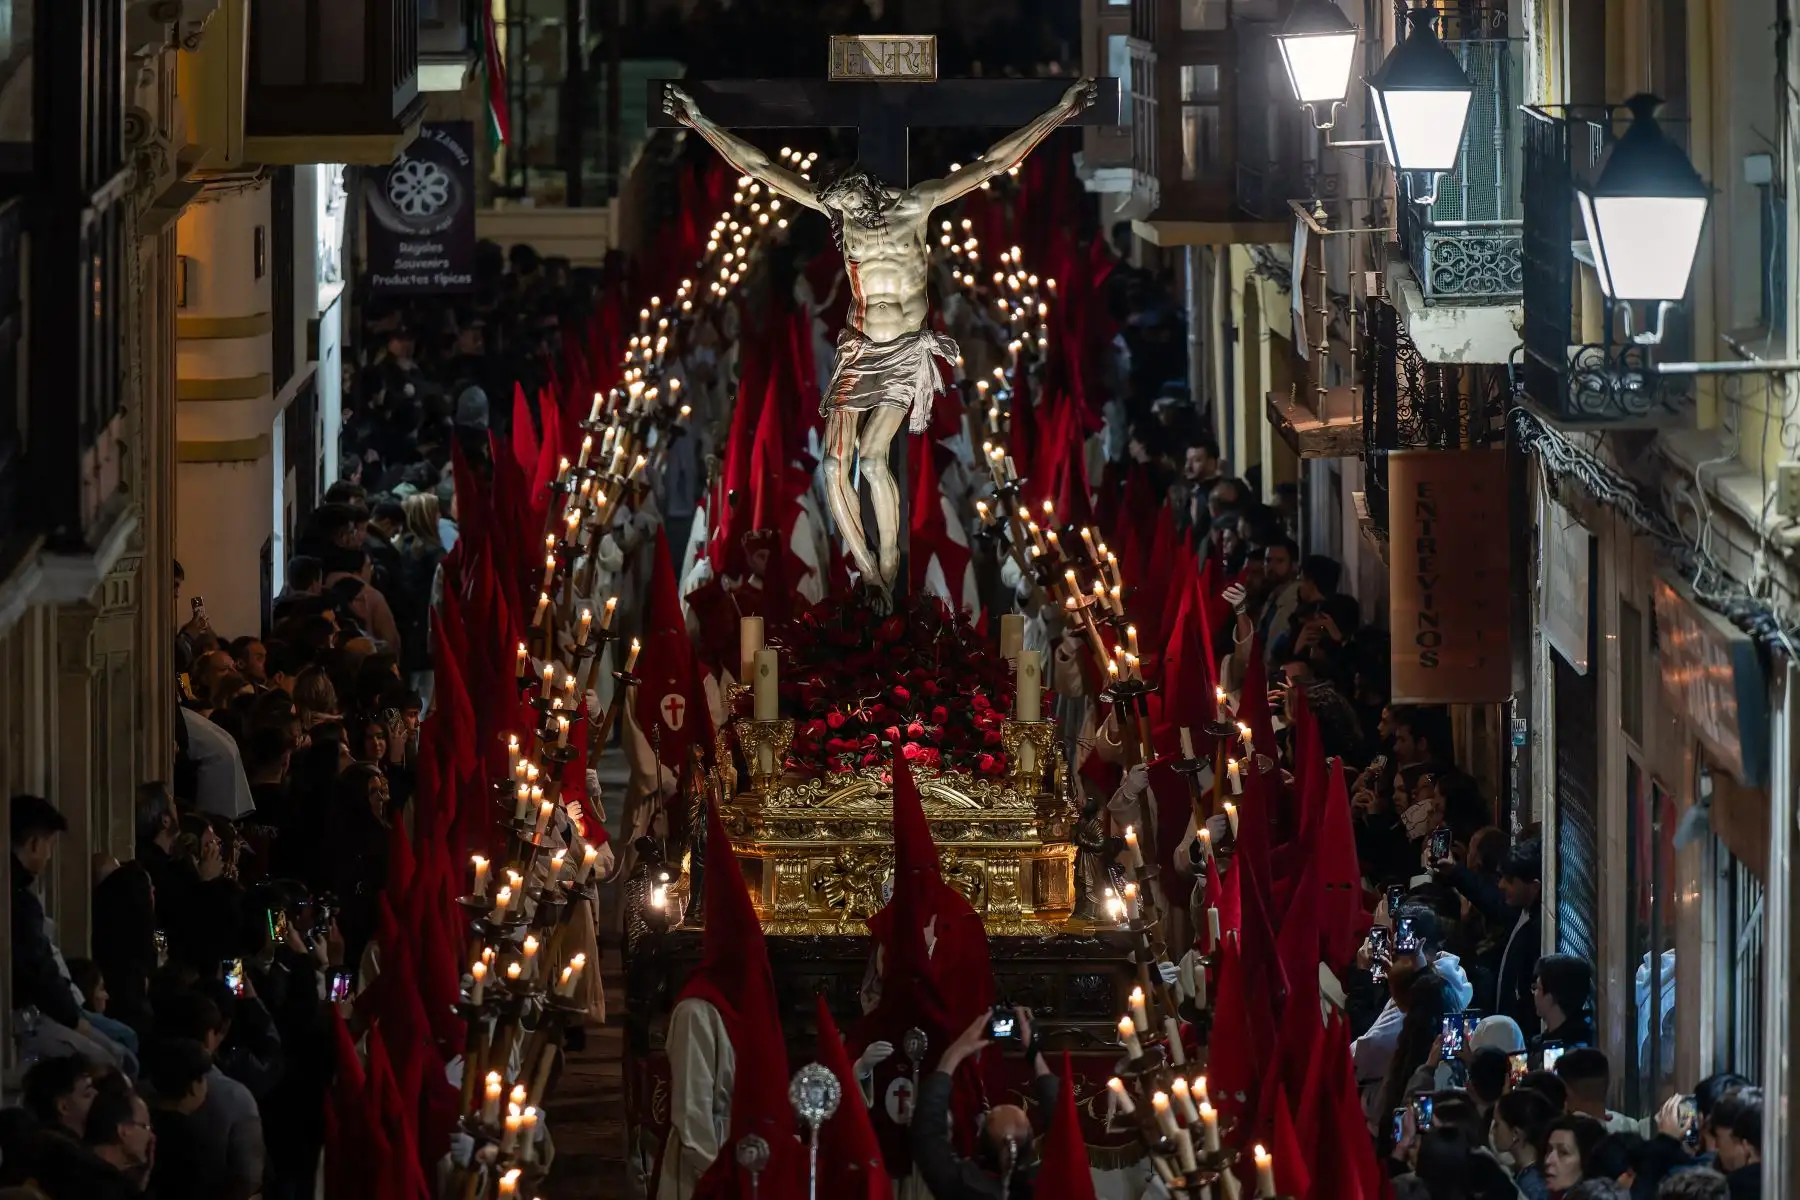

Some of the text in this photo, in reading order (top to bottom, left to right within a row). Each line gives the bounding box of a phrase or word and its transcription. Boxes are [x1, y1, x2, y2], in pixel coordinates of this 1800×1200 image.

[839, 41, 929, 75] INRI
[393, 258, 450, 269] Souvenirs
[1415, 481, 1442, 669] ENTREVINOS
